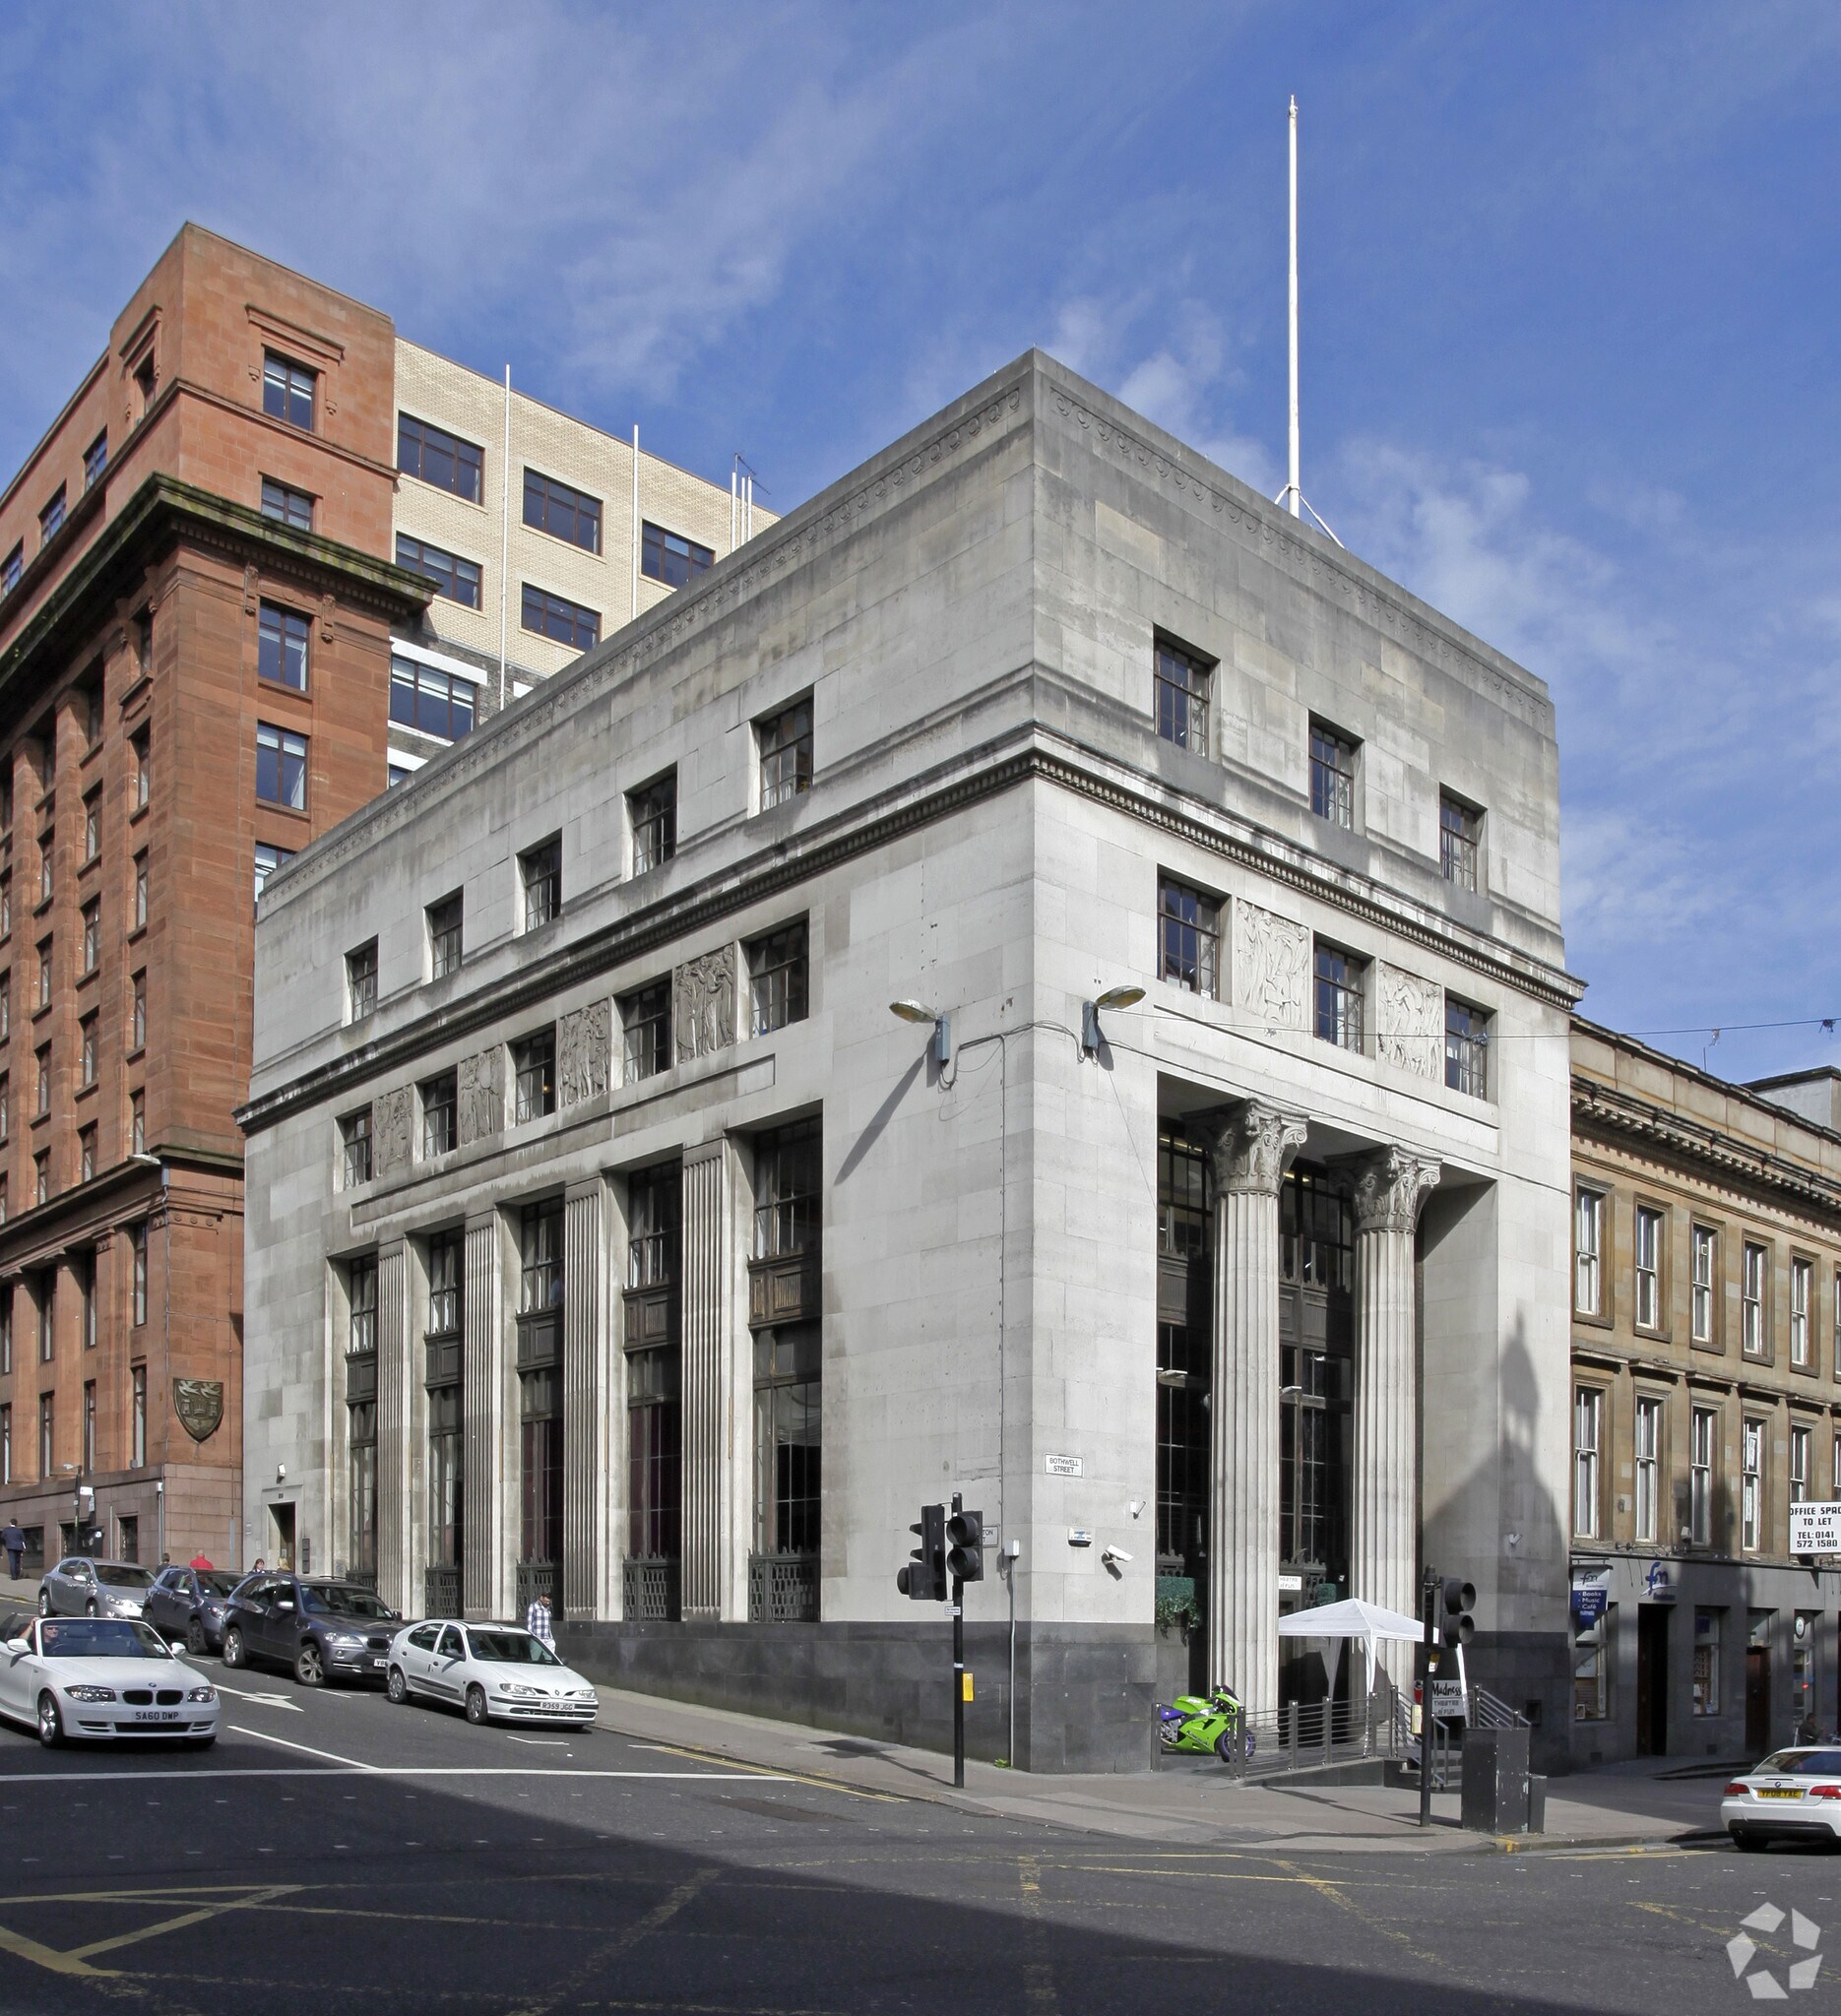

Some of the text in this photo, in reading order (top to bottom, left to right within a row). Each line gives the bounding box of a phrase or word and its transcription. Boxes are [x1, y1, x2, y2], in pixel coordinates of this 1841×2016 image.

[1049, 1458, 1079, 1467] BOTHWELL
[1790, 1507, 1816, 1516] OFFICE
[1817, 1517, 1832, 1526] LET
[1797, 1539, 1838, 1548] 572 1580
[135, 1711, 179, 1721] SA60 DWP
